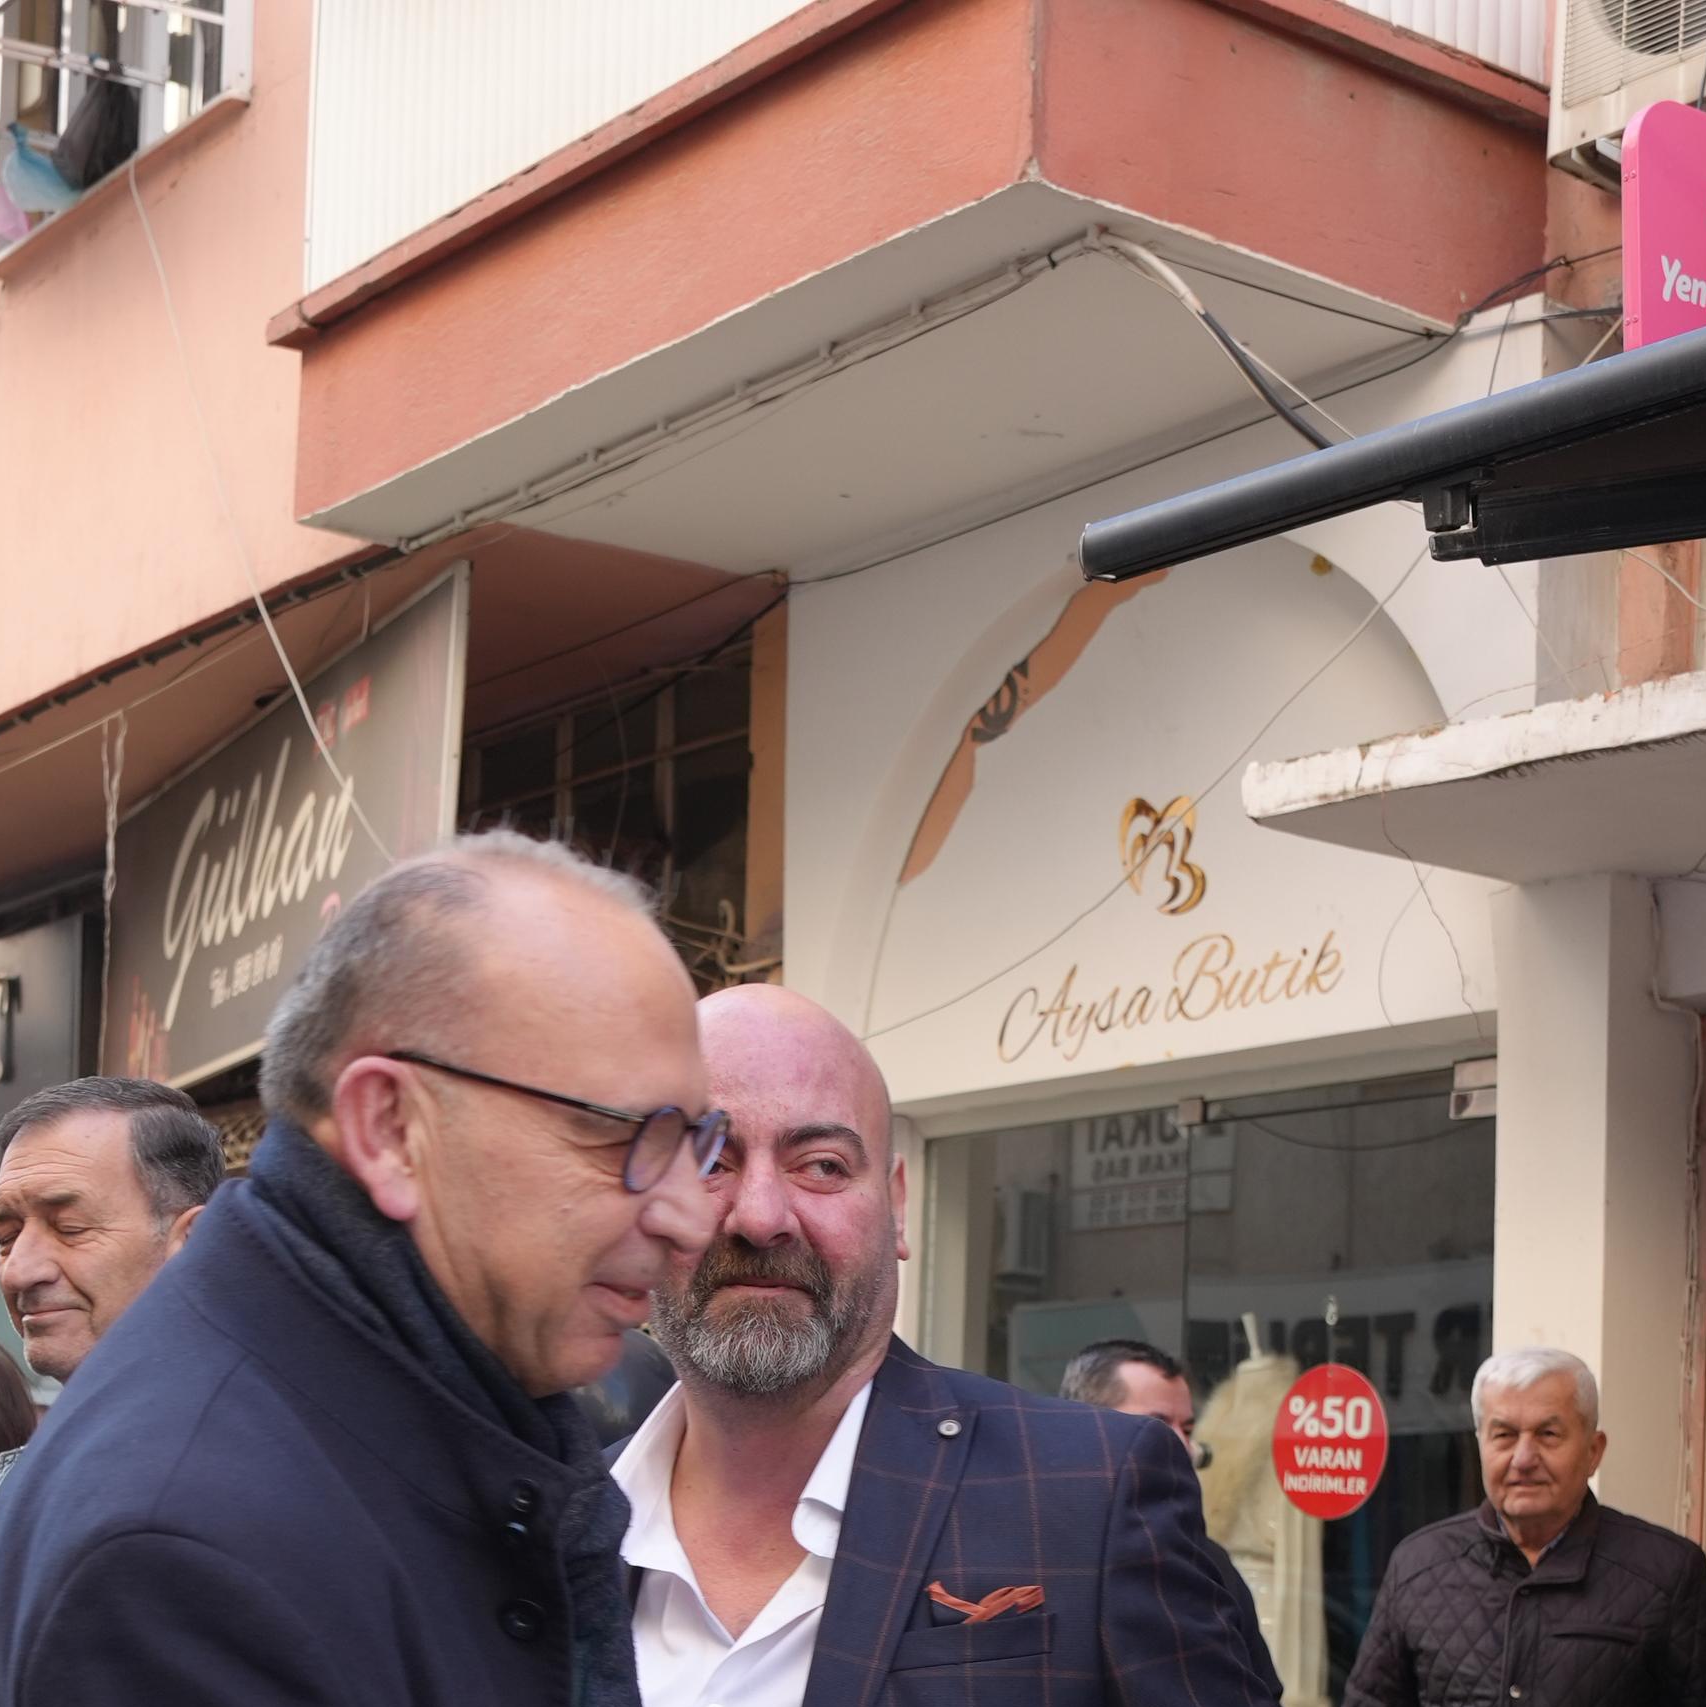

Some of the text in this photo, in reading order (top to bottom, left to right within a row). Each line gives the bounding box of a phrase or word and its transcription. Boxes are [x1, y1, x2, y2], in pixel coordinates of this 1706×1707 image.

[163, 737, 354, 1032] Gülhan
[997, 930, 1344, 1064] Aysa Butik
[1288, 1395, 1372, 1440] %50
[1294, 1445, 1363, 1471] VARAN
